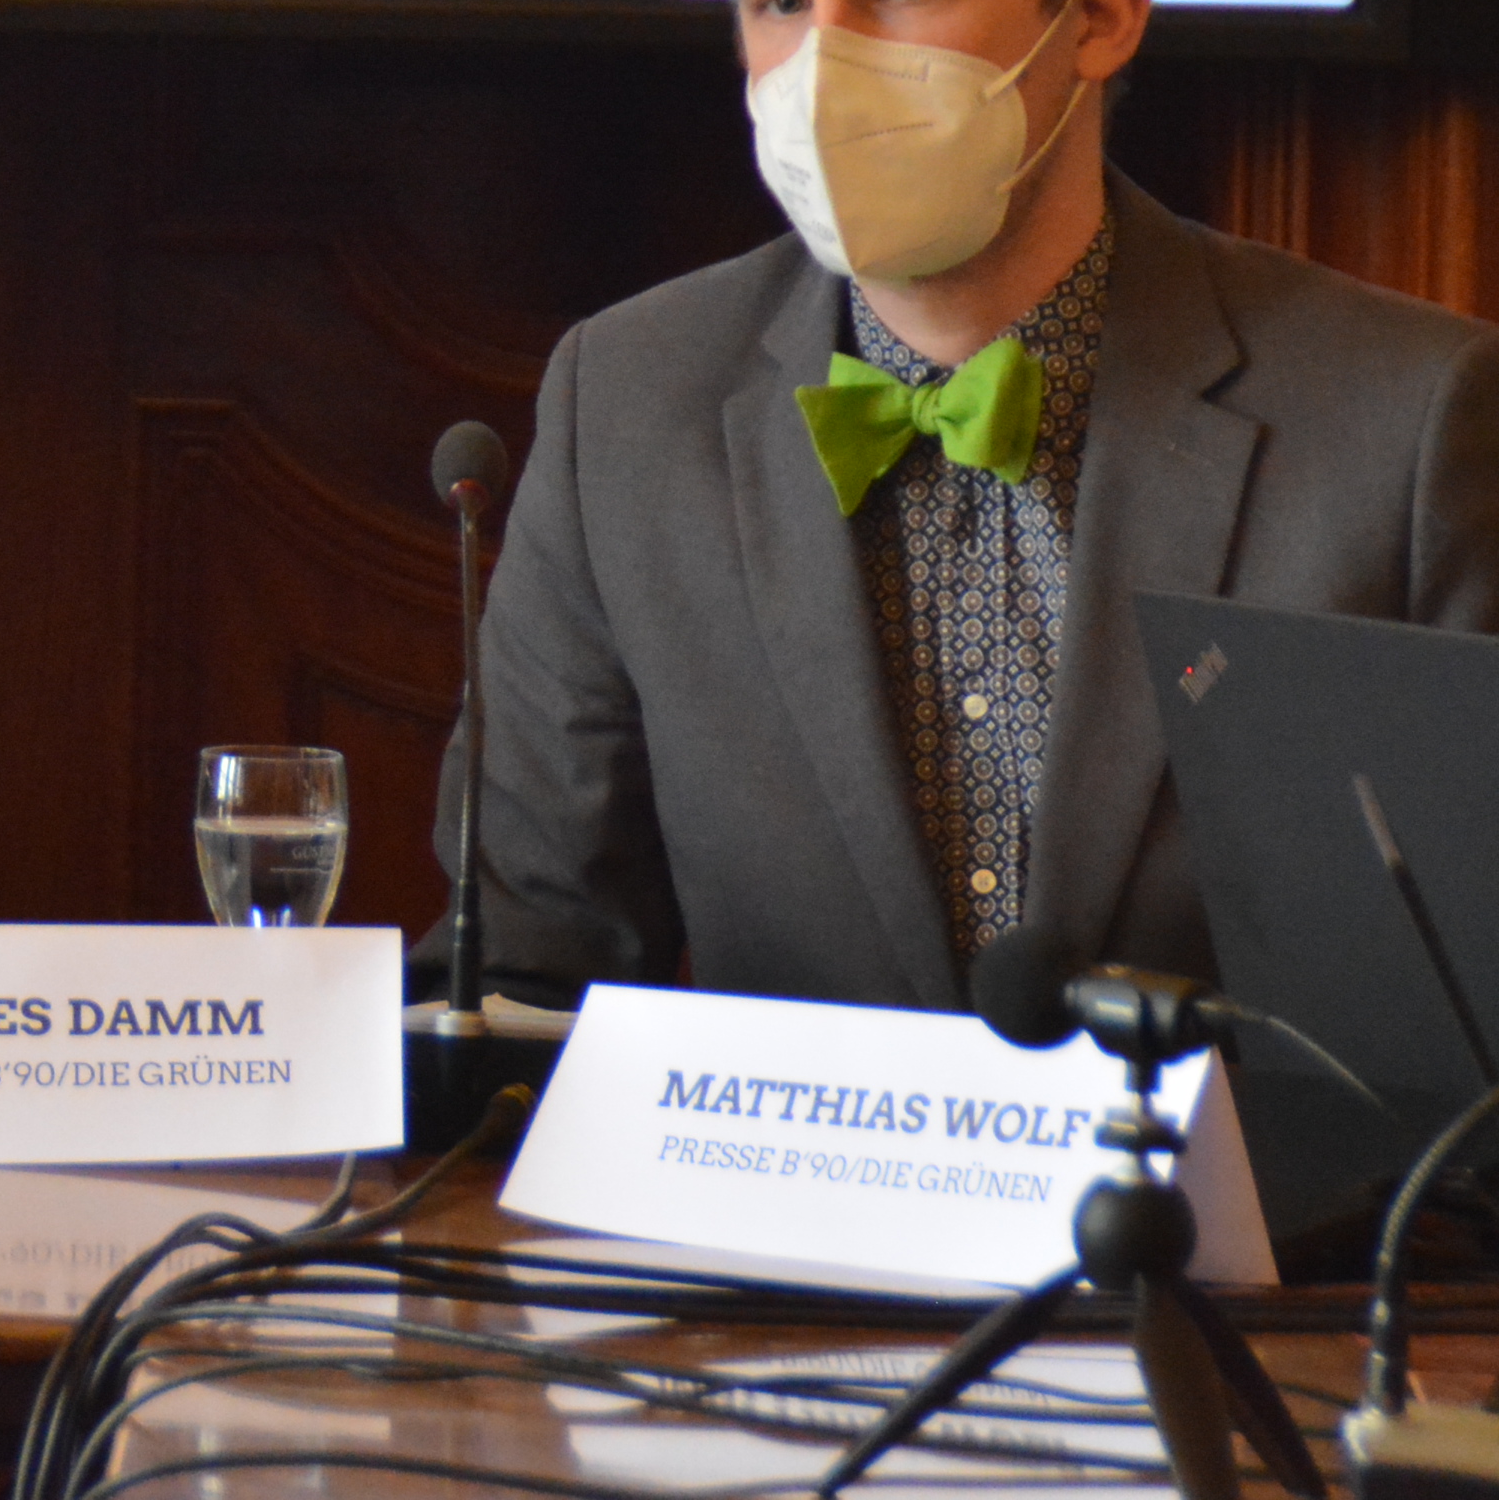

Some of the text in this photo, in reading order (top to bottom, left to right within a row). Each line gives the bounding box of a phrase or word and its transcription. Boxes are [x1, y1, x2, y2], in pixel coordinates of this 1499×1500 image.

[68, 998, 265, 1037] DAMM
[137, 1055, 293, 1087] GRÜNEN
[657, 1068, 1092, 1149] MATTHIAS WOLF
[657, 1134, 776, 1175] PRESSE
[915, 1161, 1054, 1204] GRÜNEN
